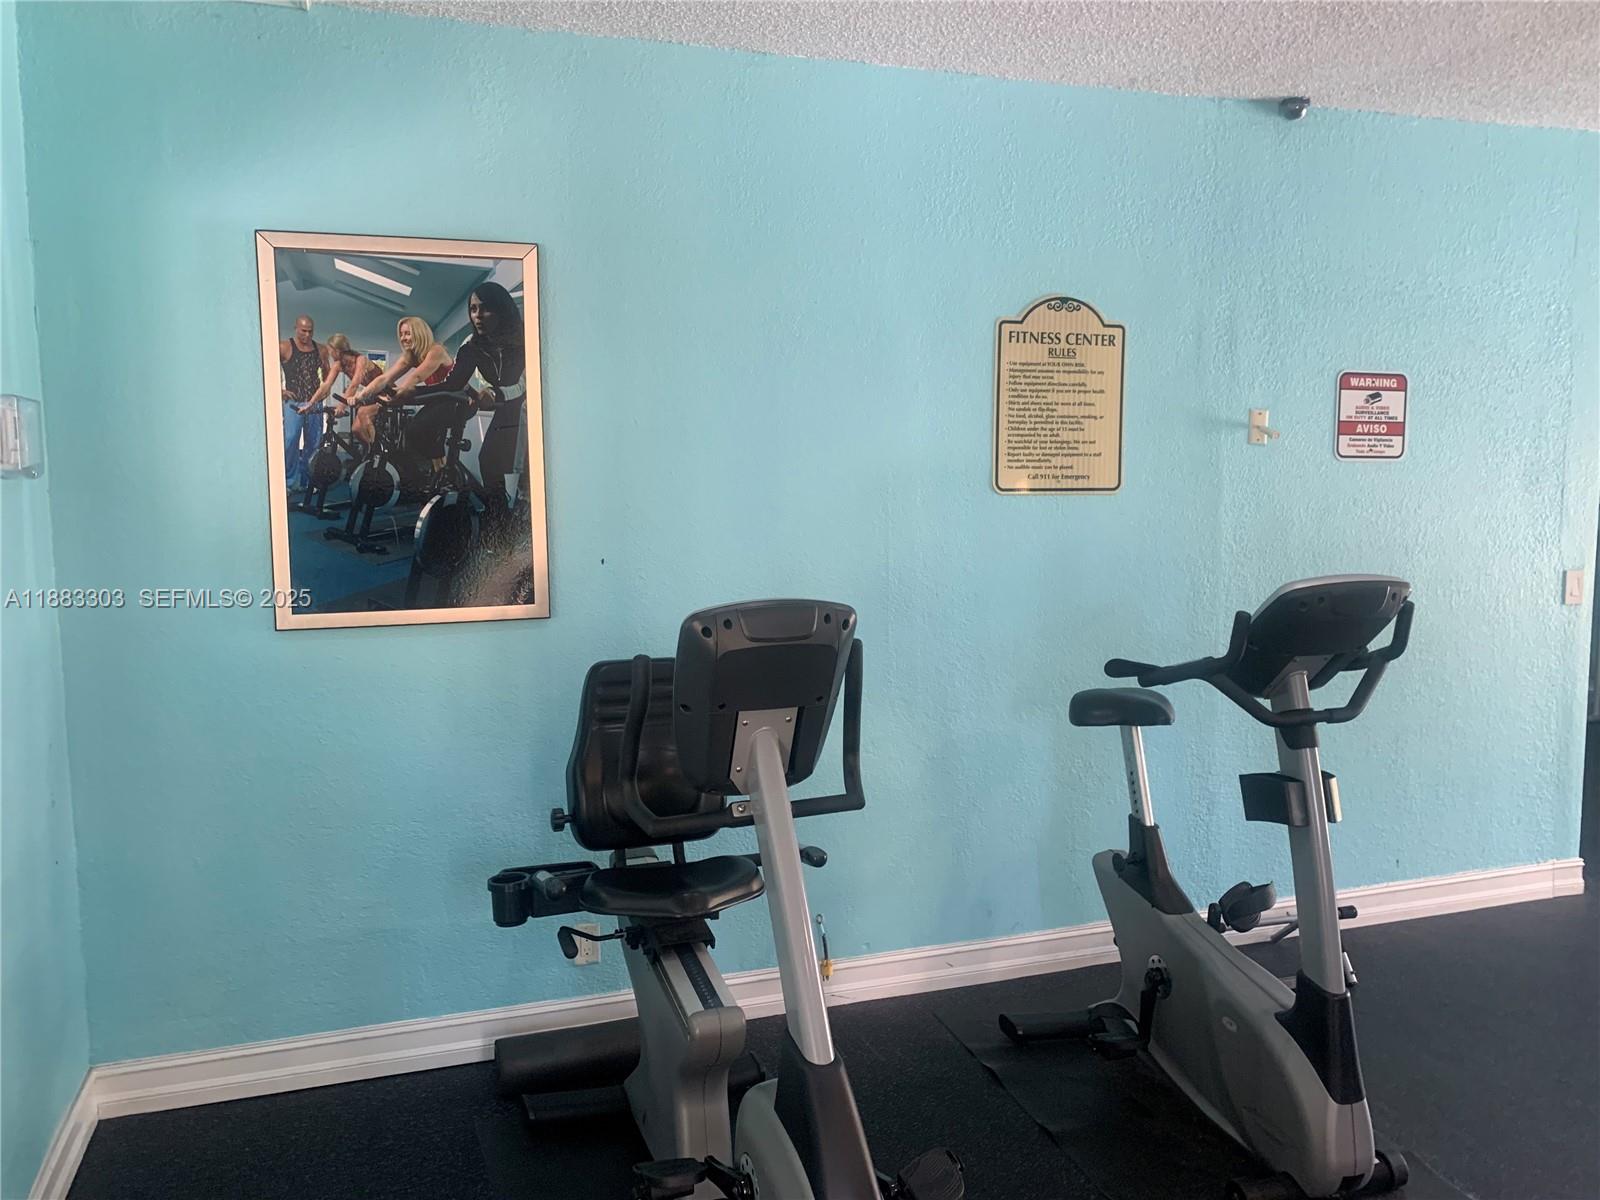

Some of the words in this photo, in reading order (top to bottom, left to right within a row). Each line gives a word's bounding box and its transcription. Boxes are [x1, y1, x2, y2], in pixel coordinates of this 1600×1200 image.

[1008, 331, 1061, 345] FITNESS
[1065, 332, 1116, 347] CENTER
[1048, 348, 1077, 357] RULES
[1350, 377, 1398, 388] WARNING
[1356, 424, 1388, 434] AVISO
